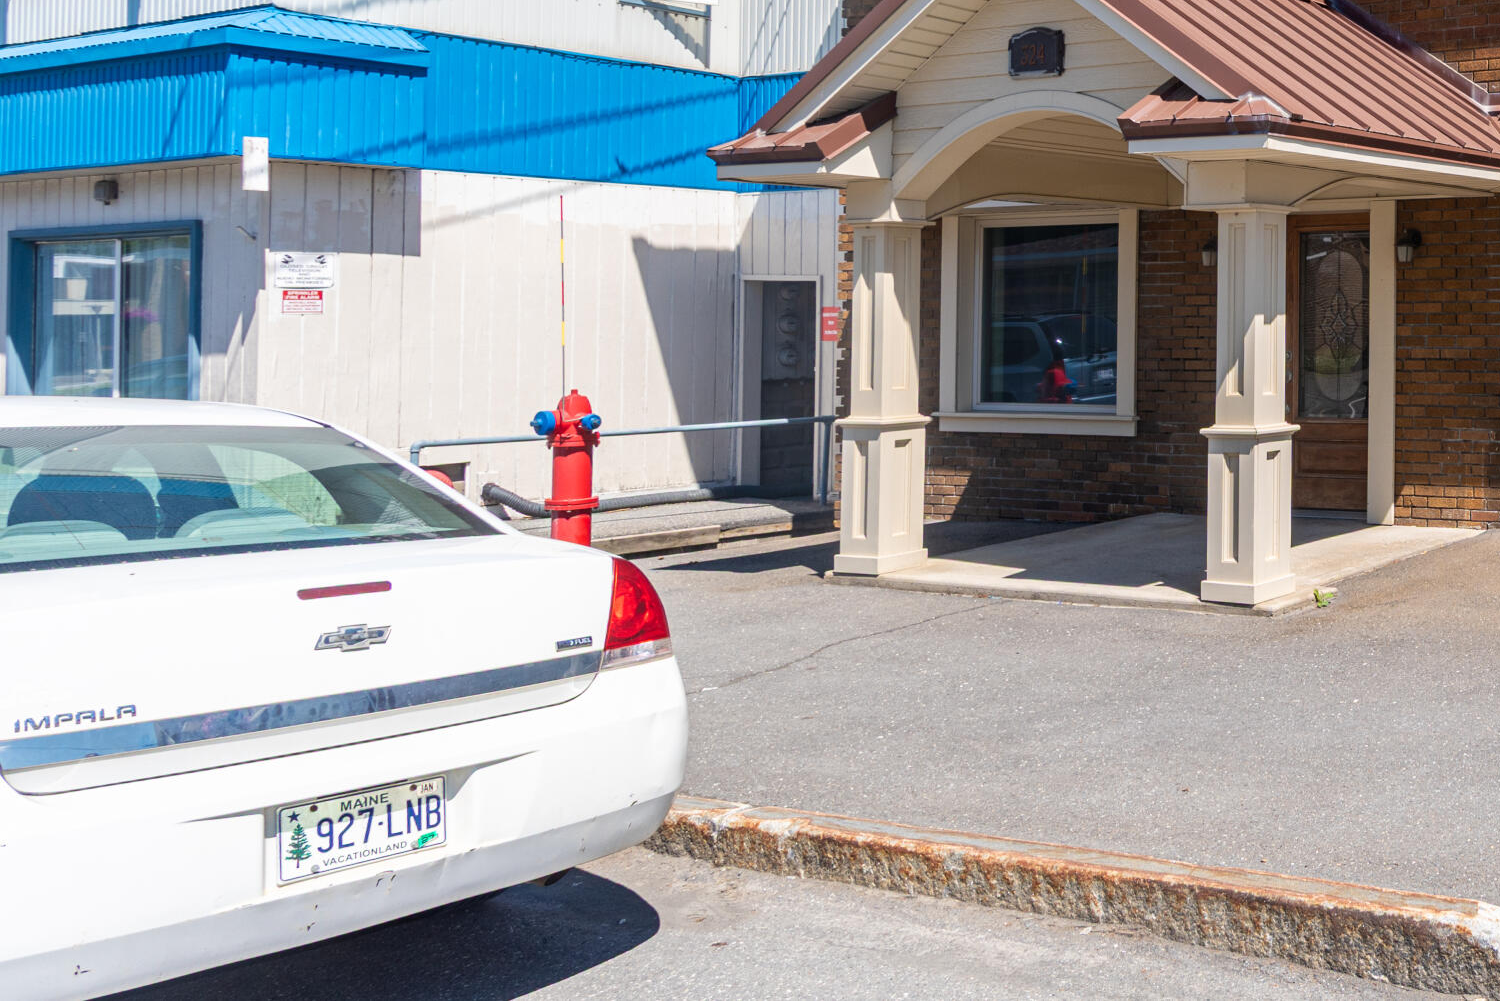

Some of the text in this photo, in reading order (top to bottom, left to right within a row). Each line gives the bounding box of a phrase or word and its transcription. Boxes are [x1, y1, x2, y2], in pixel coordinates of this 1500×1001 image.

[14, 704, 136, 733] IMPALA
[341, 783, 434, 812] MAINE JAN
[323, 841, 408, 867] VACATIONLAND
